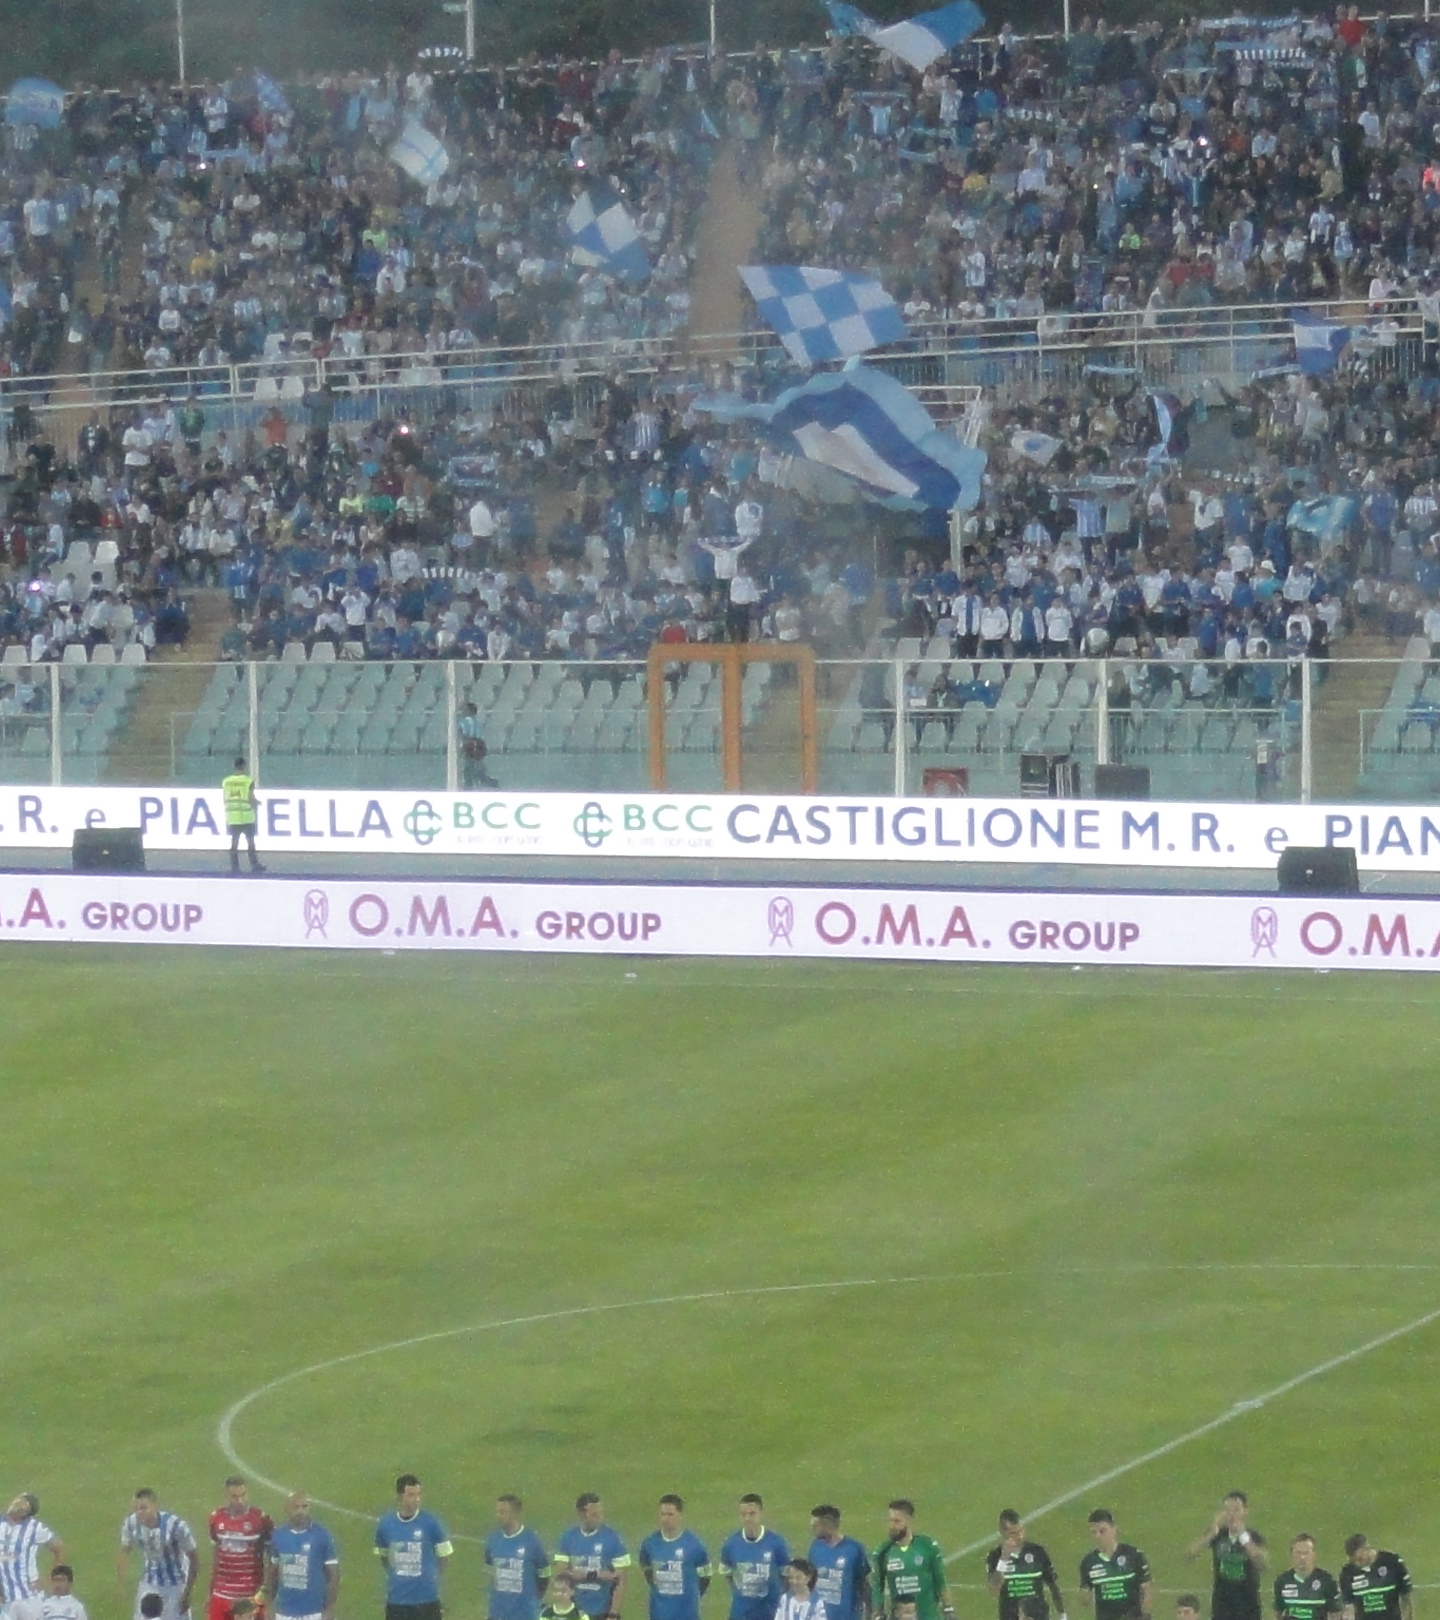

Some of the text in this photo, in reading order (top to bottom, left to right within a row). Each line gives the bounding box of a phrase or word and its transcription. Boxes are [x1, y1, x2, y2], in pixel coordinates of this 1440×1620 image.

[84, 808, 107, 831] e
[139, 797, 393, 838] PIAELLA
[453, 801, 541, 829] BCC
[623, 804, 713, 832] BCC
[726, 805, 1101, 850] CASTIGLIONE
[1264, 825, 1290, 855] e
[81, 901, 205, 933] GROUP
[348, 892, 663, 941] O.M.A. GROUP
[813, 901, 1141, 952] O.M.A. GROUP
